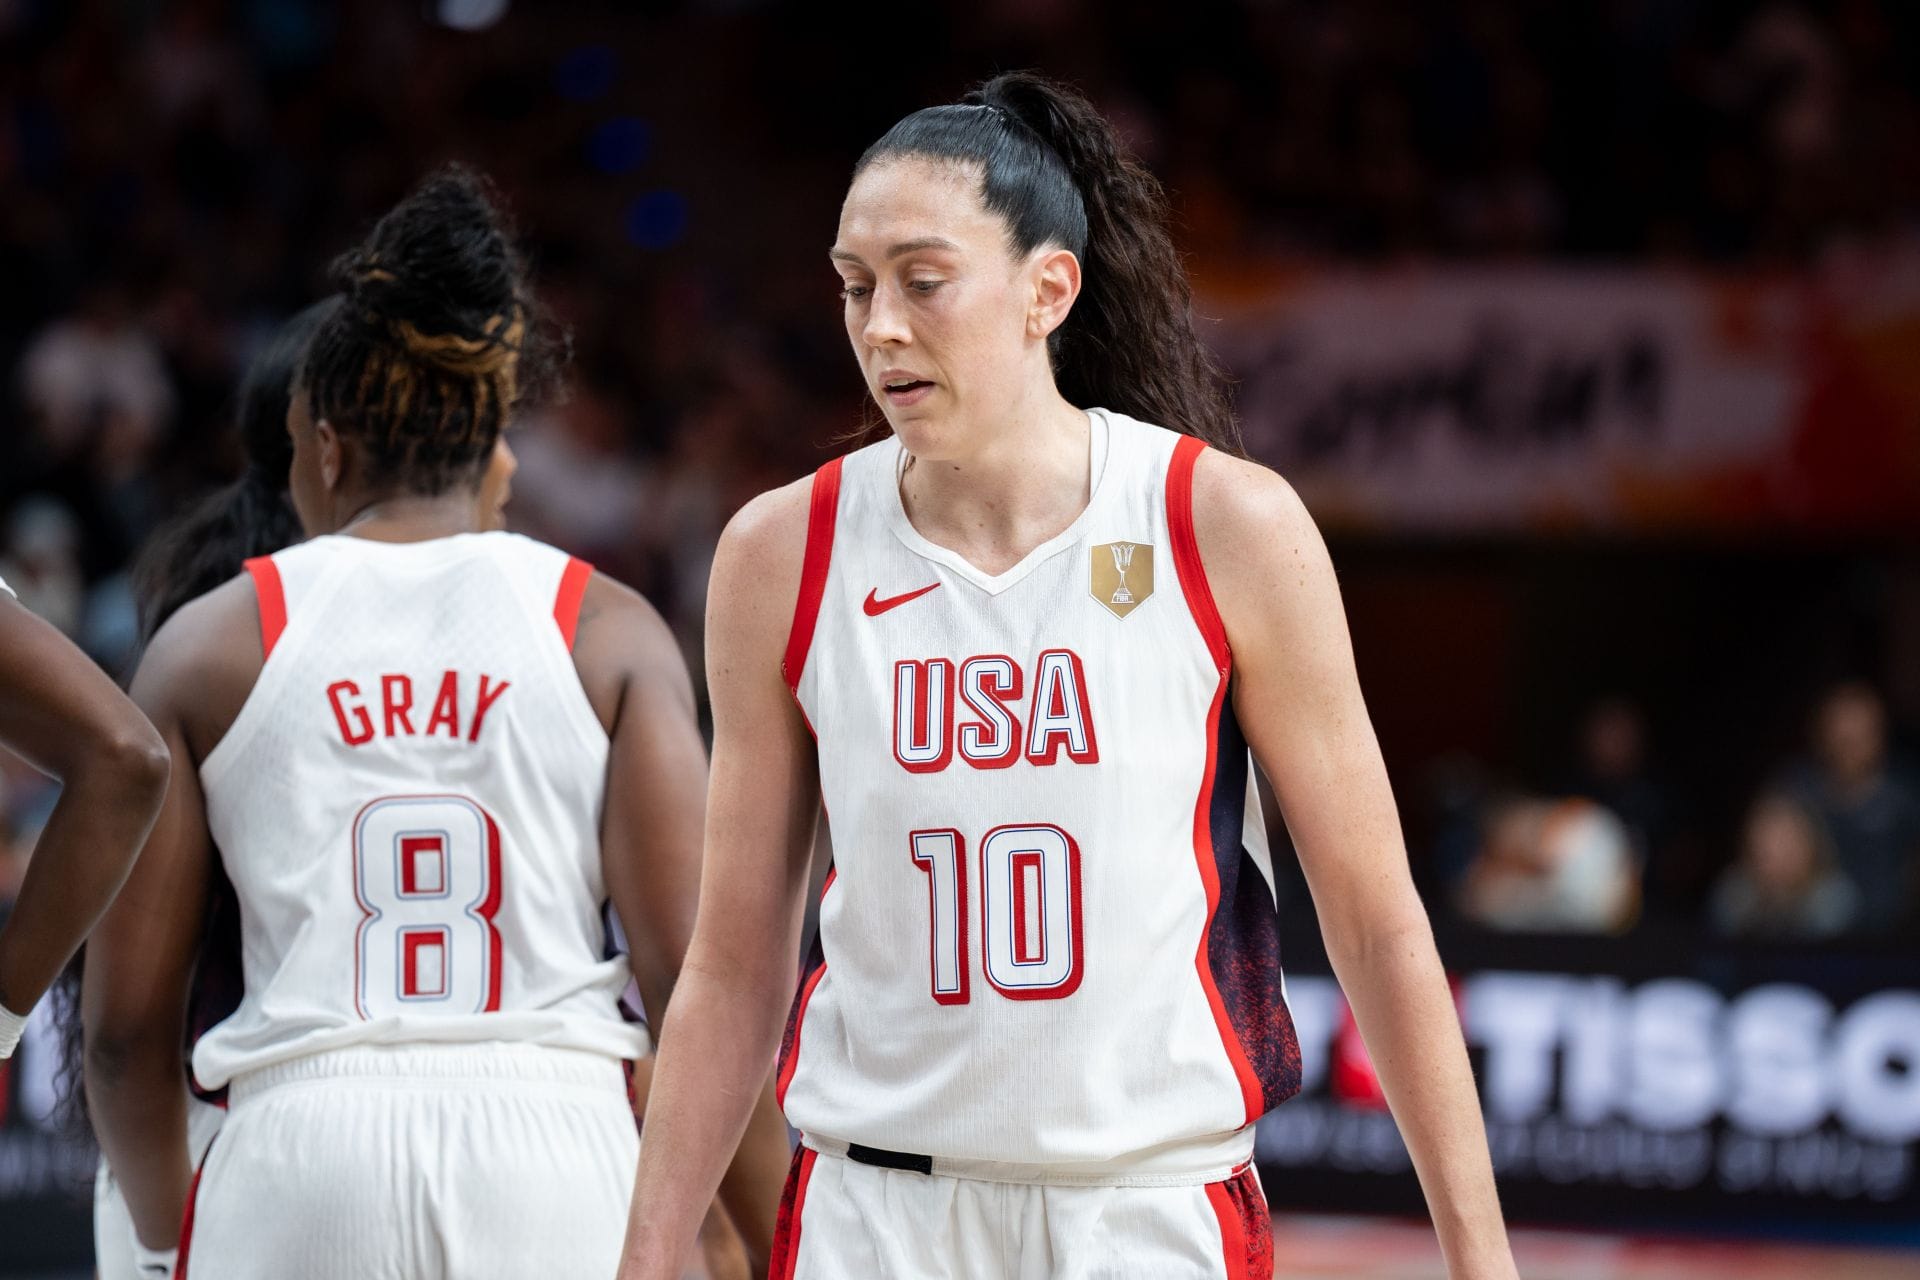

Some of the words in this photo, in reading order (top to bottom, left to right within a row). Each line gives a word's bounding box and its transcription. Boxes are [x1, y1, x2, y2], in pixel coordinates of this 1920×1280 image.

[326, 670, 511, 747] GRAY
[893, 648, 1100, 774] USA
[352, 794, 503, 1021] 8
[909, 823, 1085, 1006] 10
